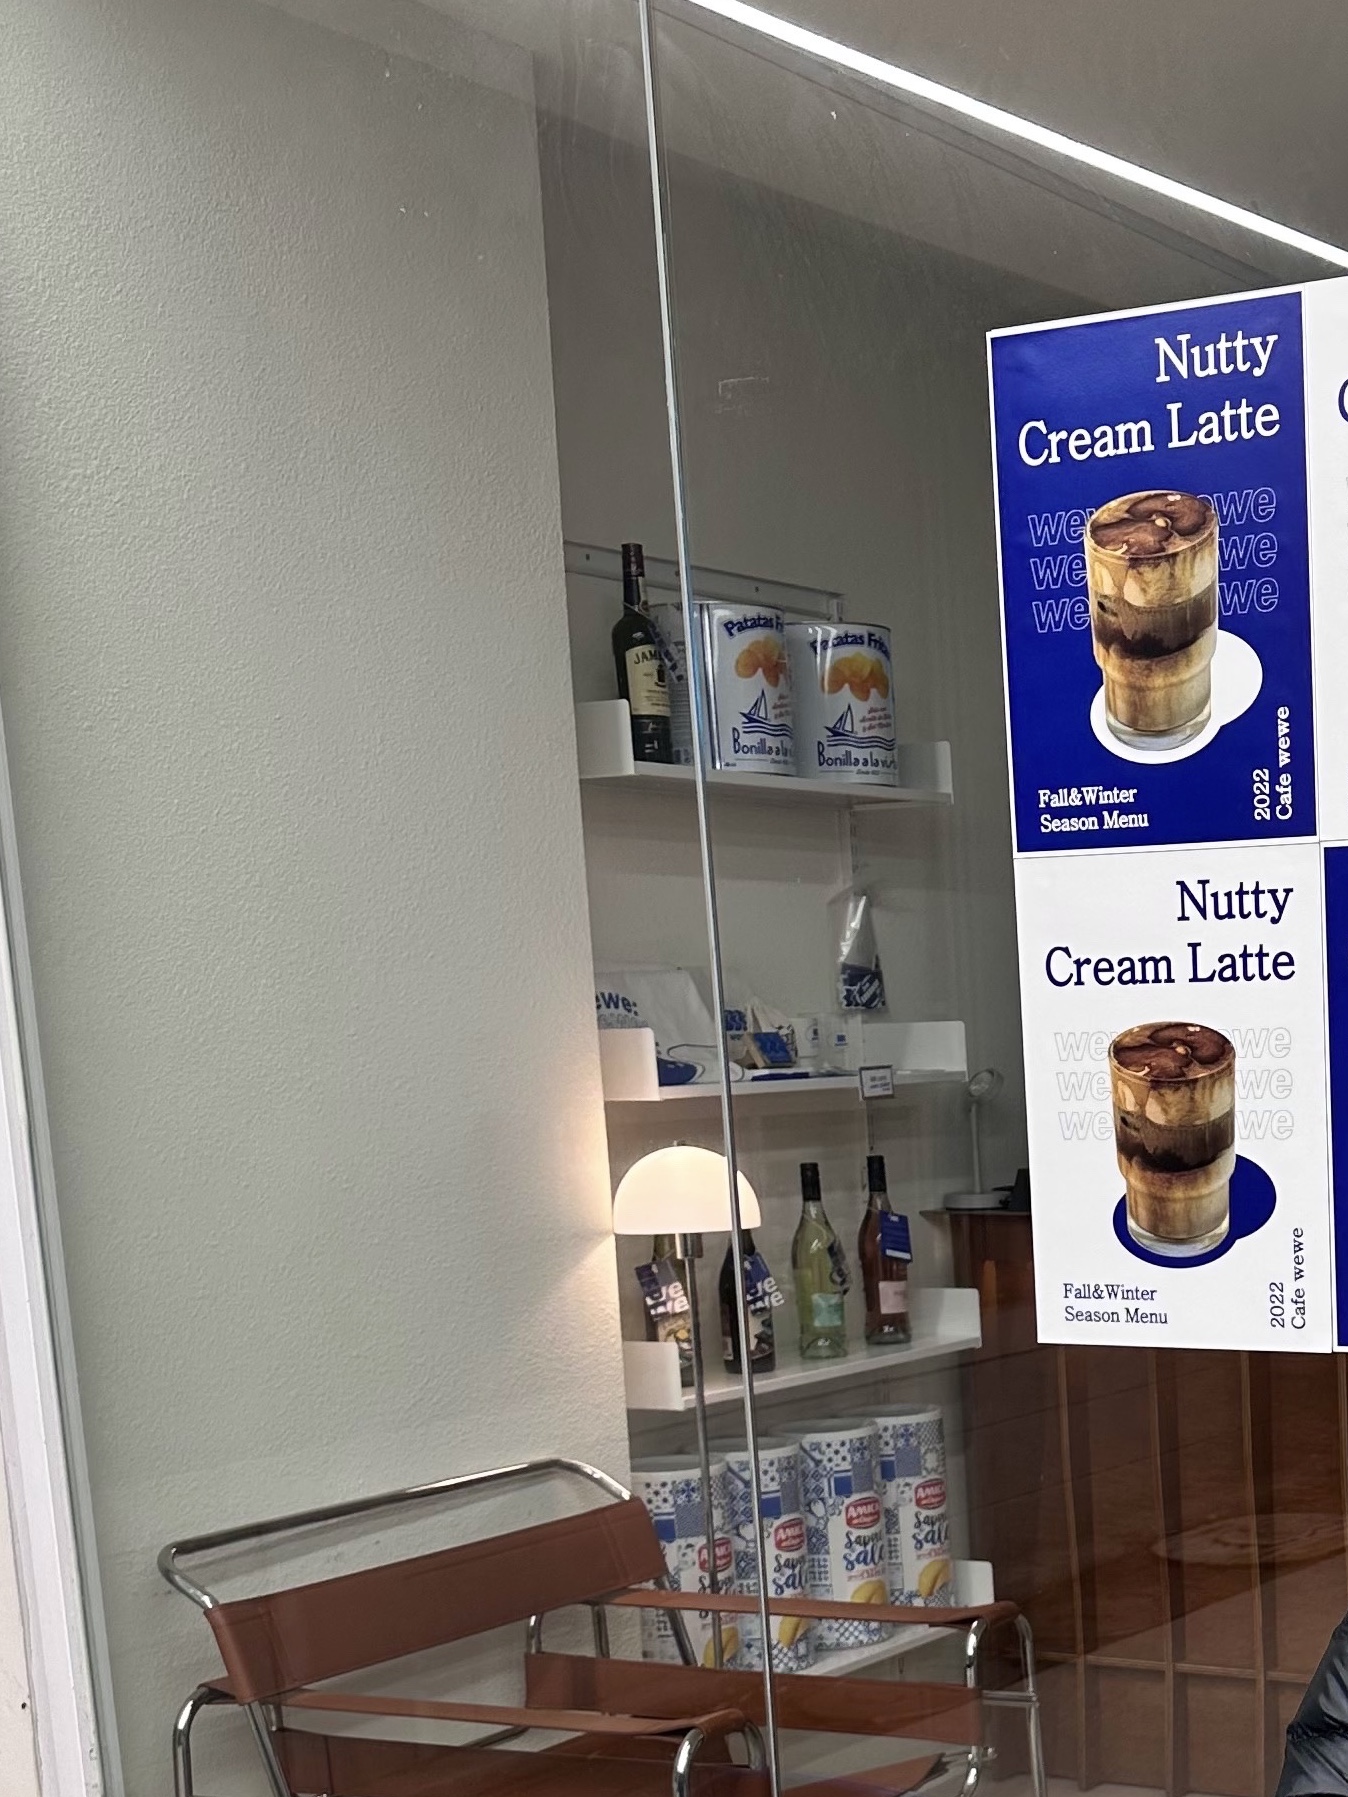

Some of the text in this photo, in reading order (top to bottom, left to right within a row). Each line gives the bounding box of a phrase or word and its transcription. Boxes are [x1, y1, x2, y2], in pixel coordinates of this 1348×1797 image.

[1154, 330, 1279, 383] Nutty
[1018, 398, 1281, 467] Cream Latte
[732, 727, 773, 755] Bonilla
[817, 741, 860, 767] Bonilla
[1275, 706, 1293, 820] Cafe wewe
[1037, 785, 1138, 808] Fall&Winter
[1252, 768, 1271, 821] 2022
[1040, 810, 1150, 833] Season Menu
[1175, 879, 1294, 925] Nutty
[1045, 941, 1296, 988] Cream Latte
[1063, 1282, 1158, 1301] Fall&Winter
[1290, 1227, 1306, 1330] Cafe wewe
[1064, 1305, 1168, 1325] Season Menu
[1269, 1282, 1285, 1329] 2022
